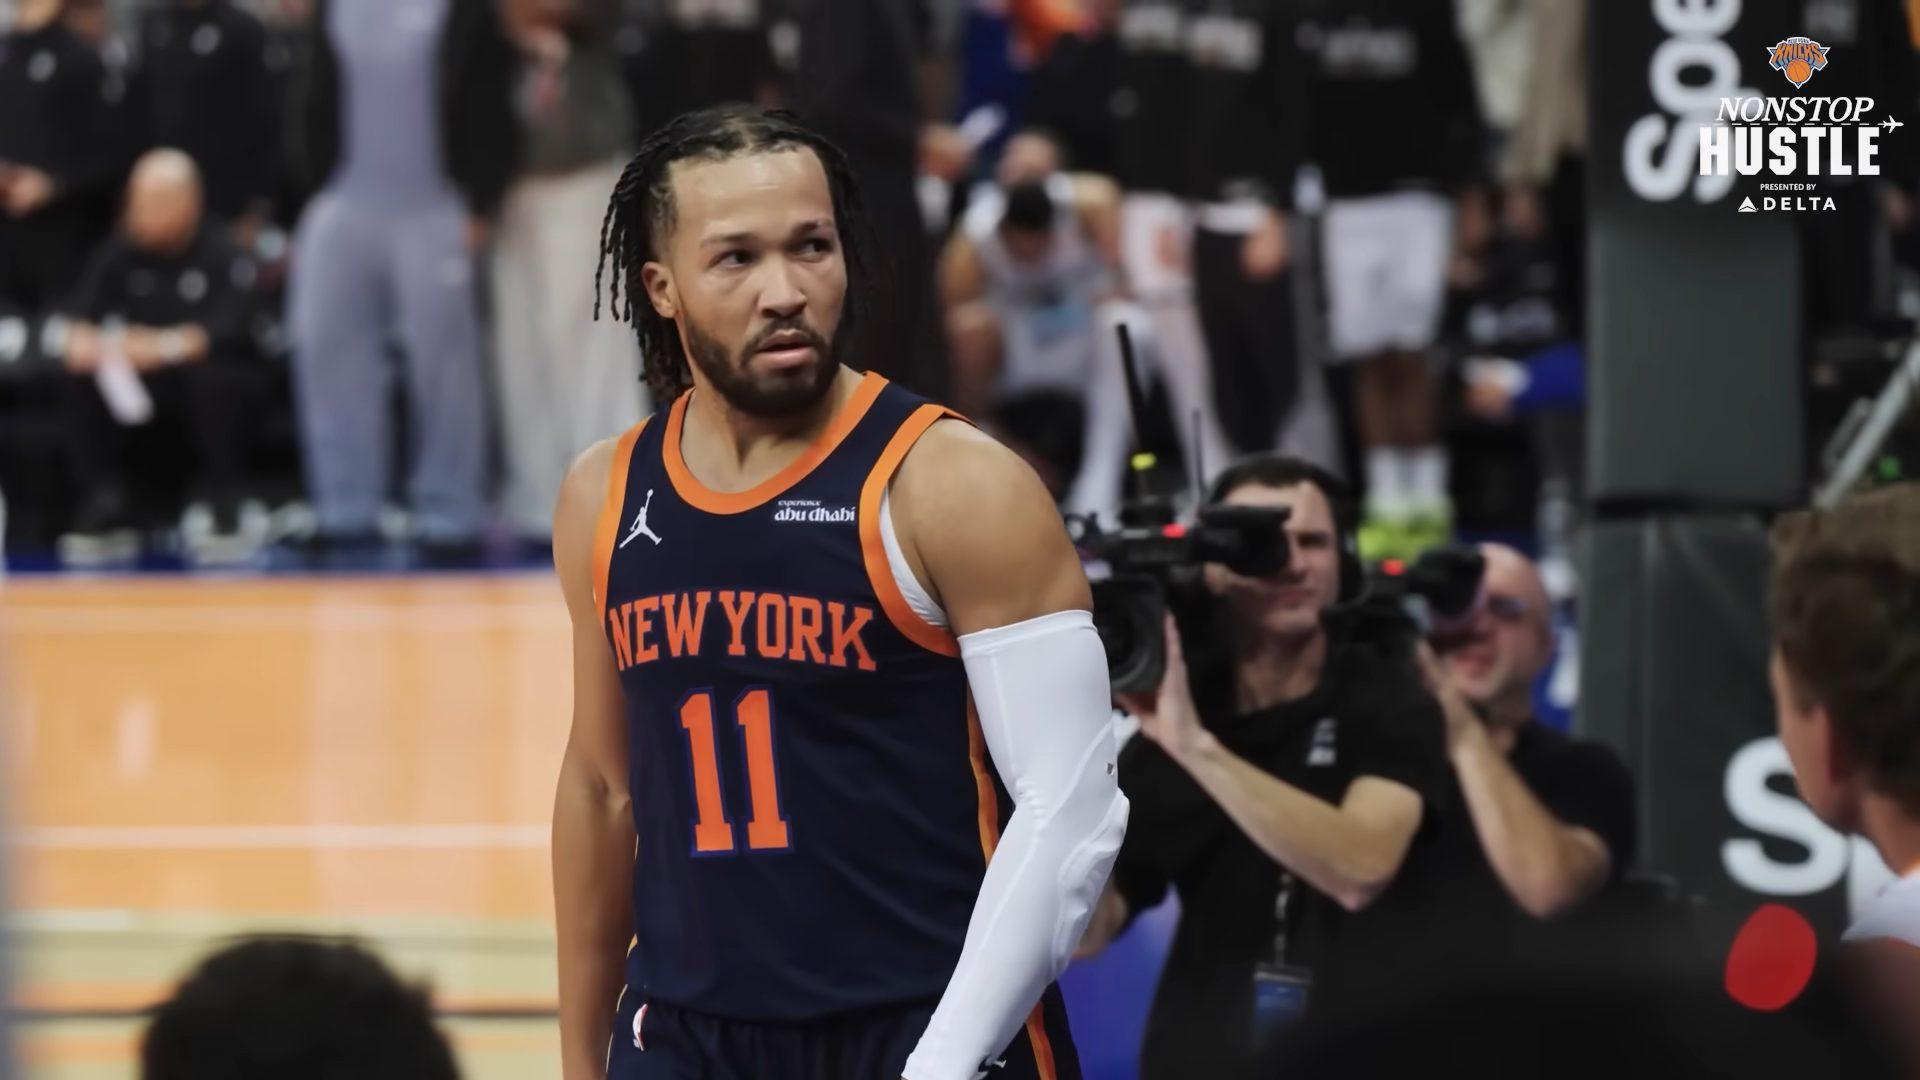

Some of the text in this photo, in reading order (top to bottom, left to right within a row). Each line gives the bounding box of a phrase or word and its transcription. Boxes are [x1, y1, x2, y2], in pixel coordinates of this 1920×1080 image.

[774, 506, 856, 522] abu dhabi
[609, 590, 877, 671] NEW YORK
[679, 688, 789, 852] 11
